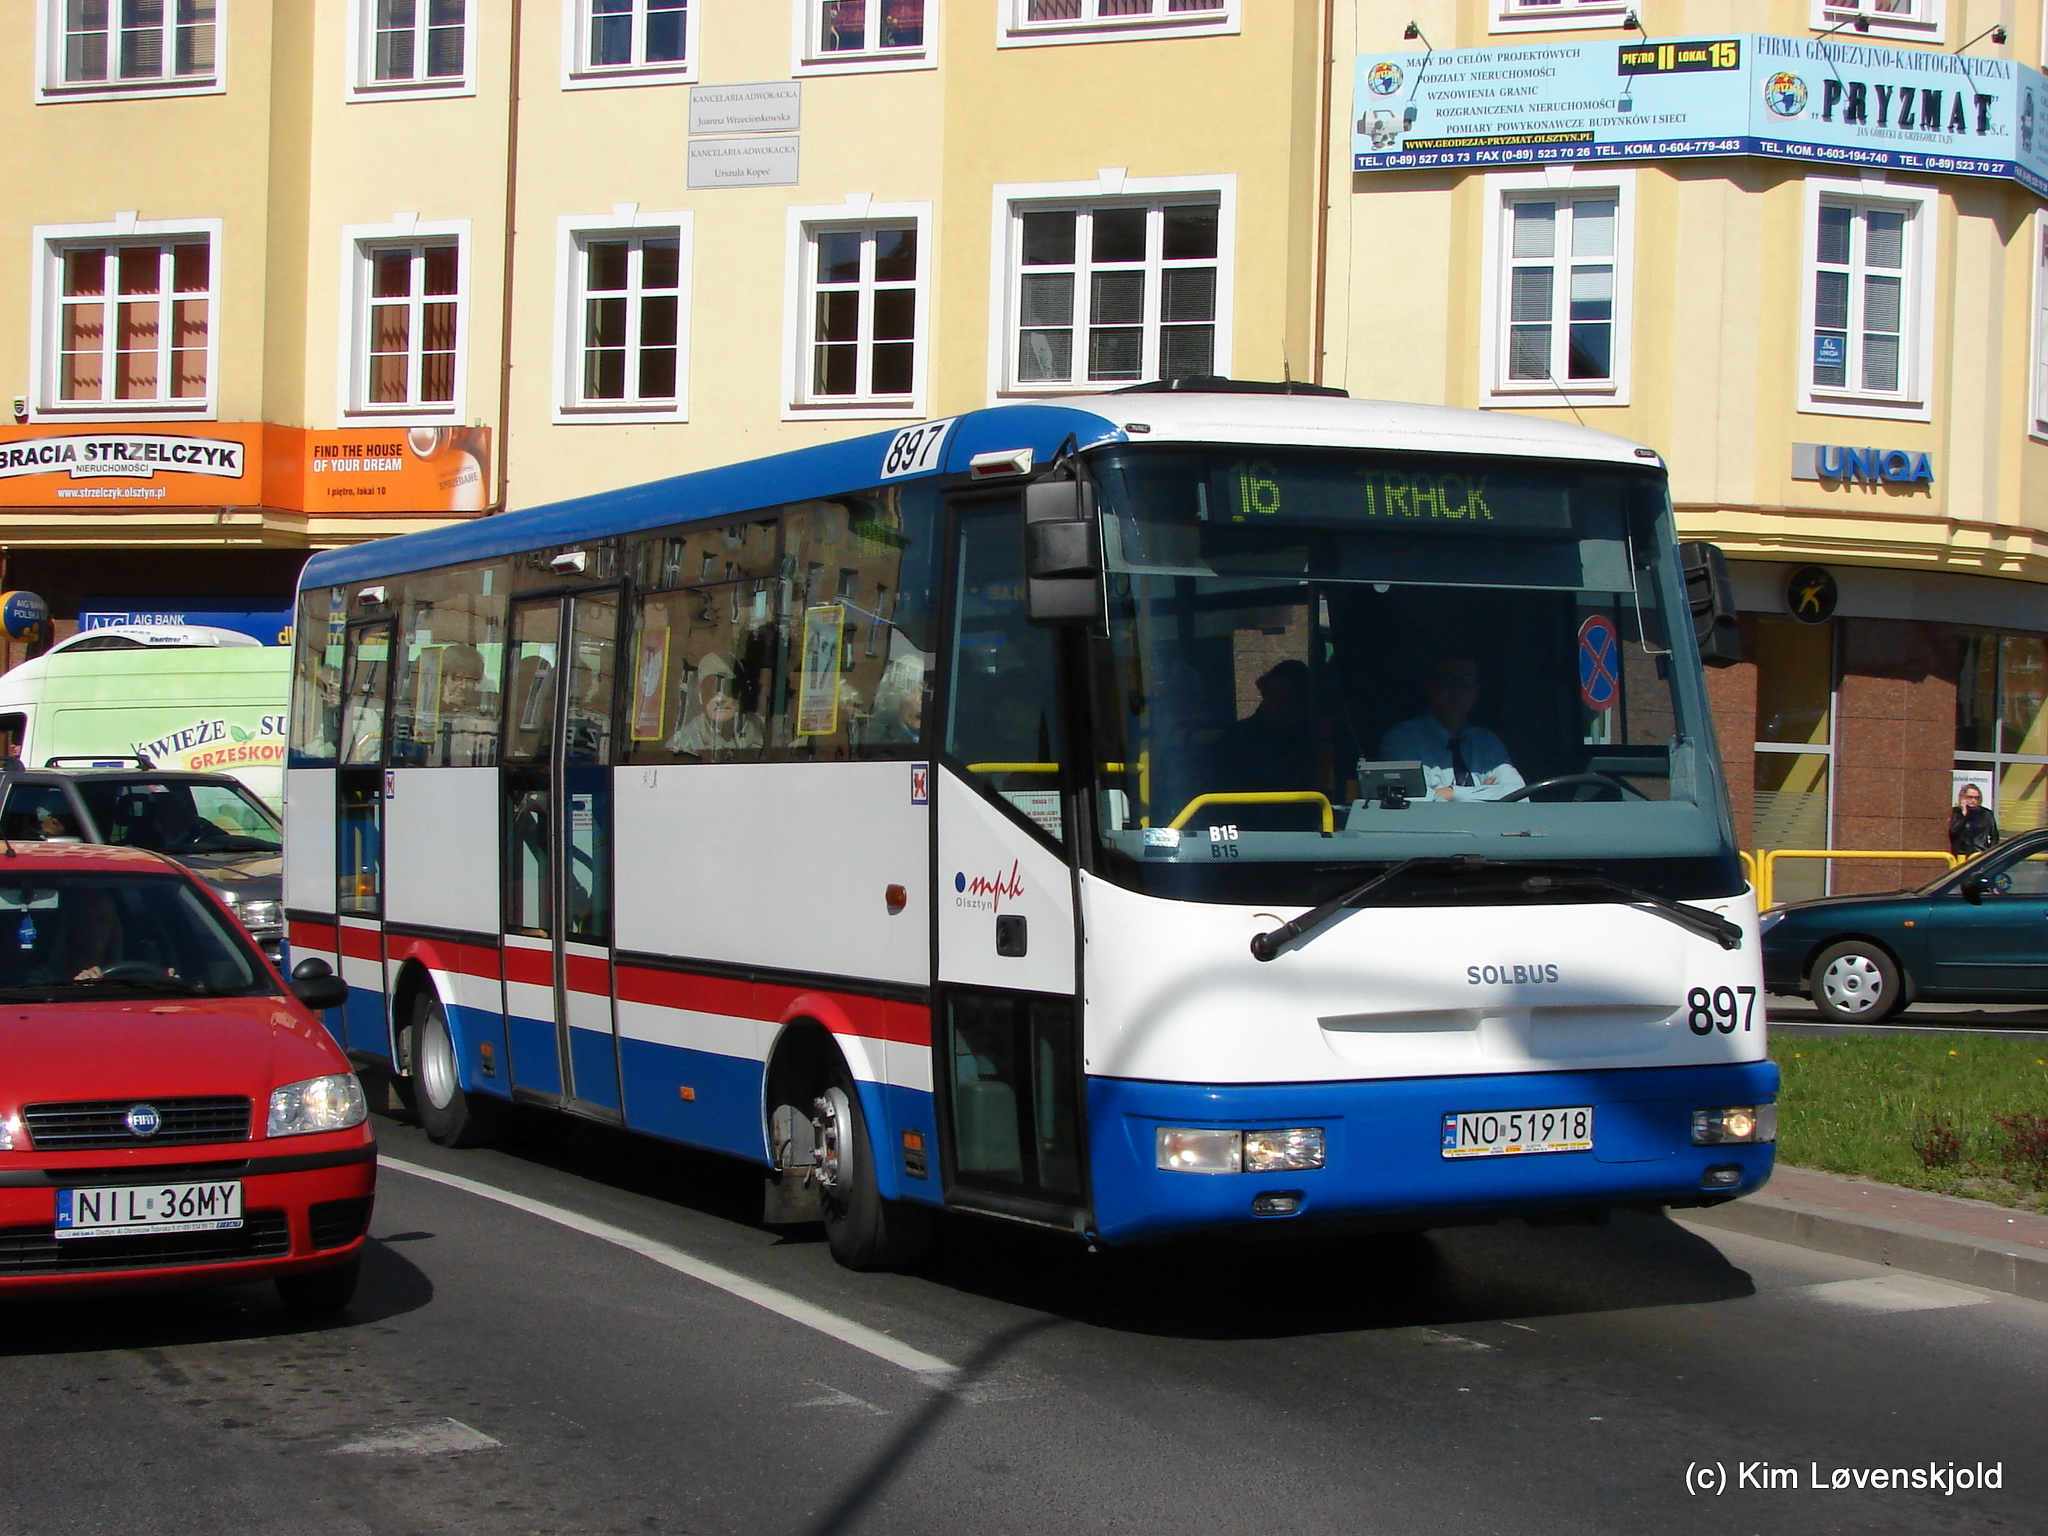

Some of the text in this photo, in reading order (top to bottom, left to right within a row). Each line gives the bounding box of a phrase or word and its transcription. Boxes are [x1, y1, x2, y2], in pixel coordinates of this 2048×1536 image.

[1406, 48, 1580, 68] MAPY DO CELÓW PROJEKTOWYCH
[1621, 42, 1737, 70] PIĘTRO II LOKAL 15
[1758, 36, 2011, 80] FIRMA GEODEZYJNO-KARTOGRAFICZNA
[1470, 66, 1556, 81] NIERUCHOMOŚCI
[693, 91, 798, 103] KANCELARIA ADWOKACKA
[1427, 86, 1539, 101] WZNOWIENIA GRANIC
[1436, 98, 1616, 118] ROZGRANICZENIA NIERUCHOMOŚCI
[698, 113, 791, 127] Joanna Wrzecionkowska
[1446, 113, 1687, 134] POMIARY POWYKONAWCZE BUDYNKÓW I SIECI
[1405, 133, 1593, 150] WWW.GEODEZJA-PRYZMAT.OLSZTYN.PL
[1857, 127, 1869, 137] JAN
[1870, 126, 1897, 139] GÓRECKI
[1904, 132, 1937, 143] GRZEGORZ
[691, 146, 796, 158] KANCELARIA ADWOKACKA
[1358, 140, 1740, 168] TEL. (0-89) 527 03 73 FAX (0-89) 523 70 26 TEL. KOM. 0-604-779-483
[1760, 141, 2005, 173] TEL. KOM. 0-603-194-740 TEL. (0-89) 523 70 27
[714, 167, 771, 178] Urszula Kopeć
[83, 442, 237, 469] STRZELCZYK
[314, 443, 403, 458] FIND THE HOUSE
[886, 423, 946, 475] 897
[76, 463, 149, 473] NIERUCHOMOŚCI
[313, 457, 402, 472] OF YOUR DREAM
[1820, 445, 1935, 483] UNIQA
[57, 486, 167, 500] www.strzelczyk.olsztyn.pl
[357, 487, 375, 496] lokal
[377, 487, 386, 496] 10
[1230, 460, 1494, 520] 16 TRACK
[134, 614, 186, 626] AIG BANK
[1209, 824, 1239, 842] B15
[967, 857, 1025, 913] mpk
[955, 896, 993, 911] Olsztyn
[1467, 963, 1559, 986] SOLBUS
[1687, 985, 1757, 1036] 897
[132, 1115, 156, 1127] FIAT
[1461, 1111, 1587, 1146] NO 51918
[1445, 1135, 1456, 1144] PL
[79, 1184, 237, 1223] NIL 36MY
[59, 1212, 72, 1222] PL
